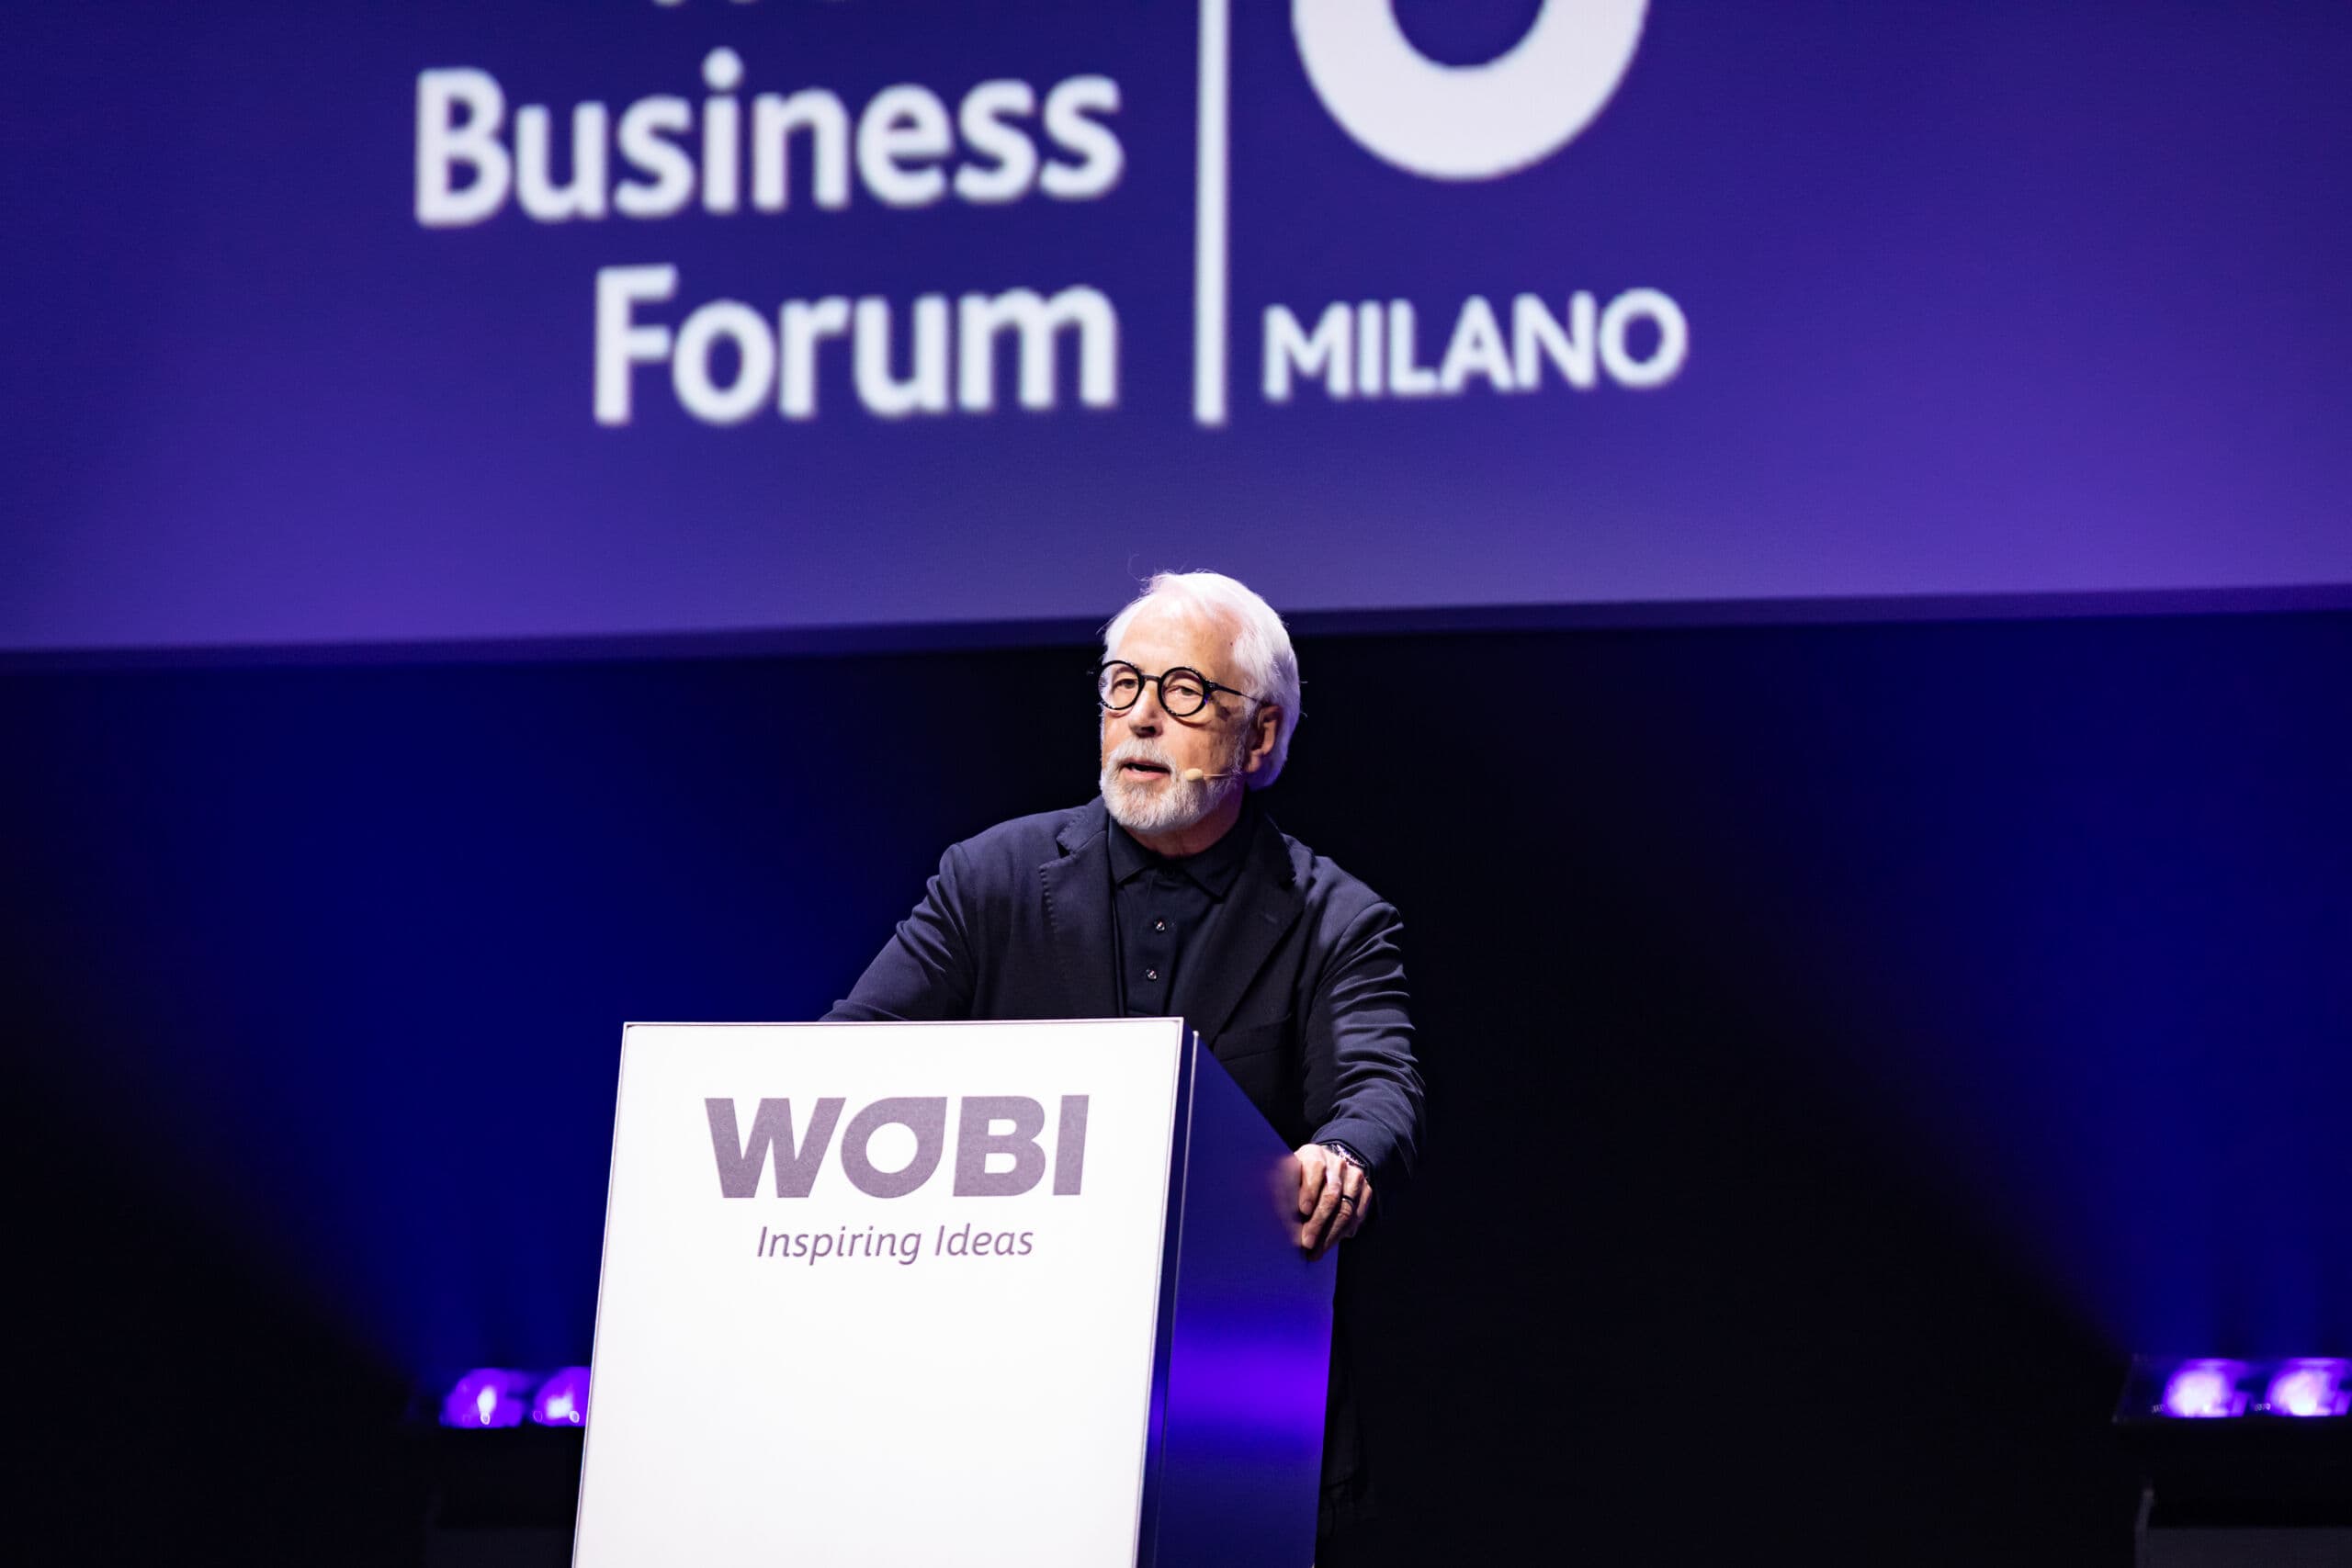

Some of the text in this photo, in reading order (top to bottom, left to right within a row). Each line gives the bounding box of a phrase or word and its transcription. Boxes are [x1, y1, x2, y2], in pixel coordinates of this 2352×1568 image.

[415, 48, 1124, 227] Business
[594, 264, 1118, 425] Forum
[1262, 288, 1689, 402] MILANO
[705, 1094, 1090, 1200] WOBI
[756, 1223, 1034, 1267] Inspiring Ideas
